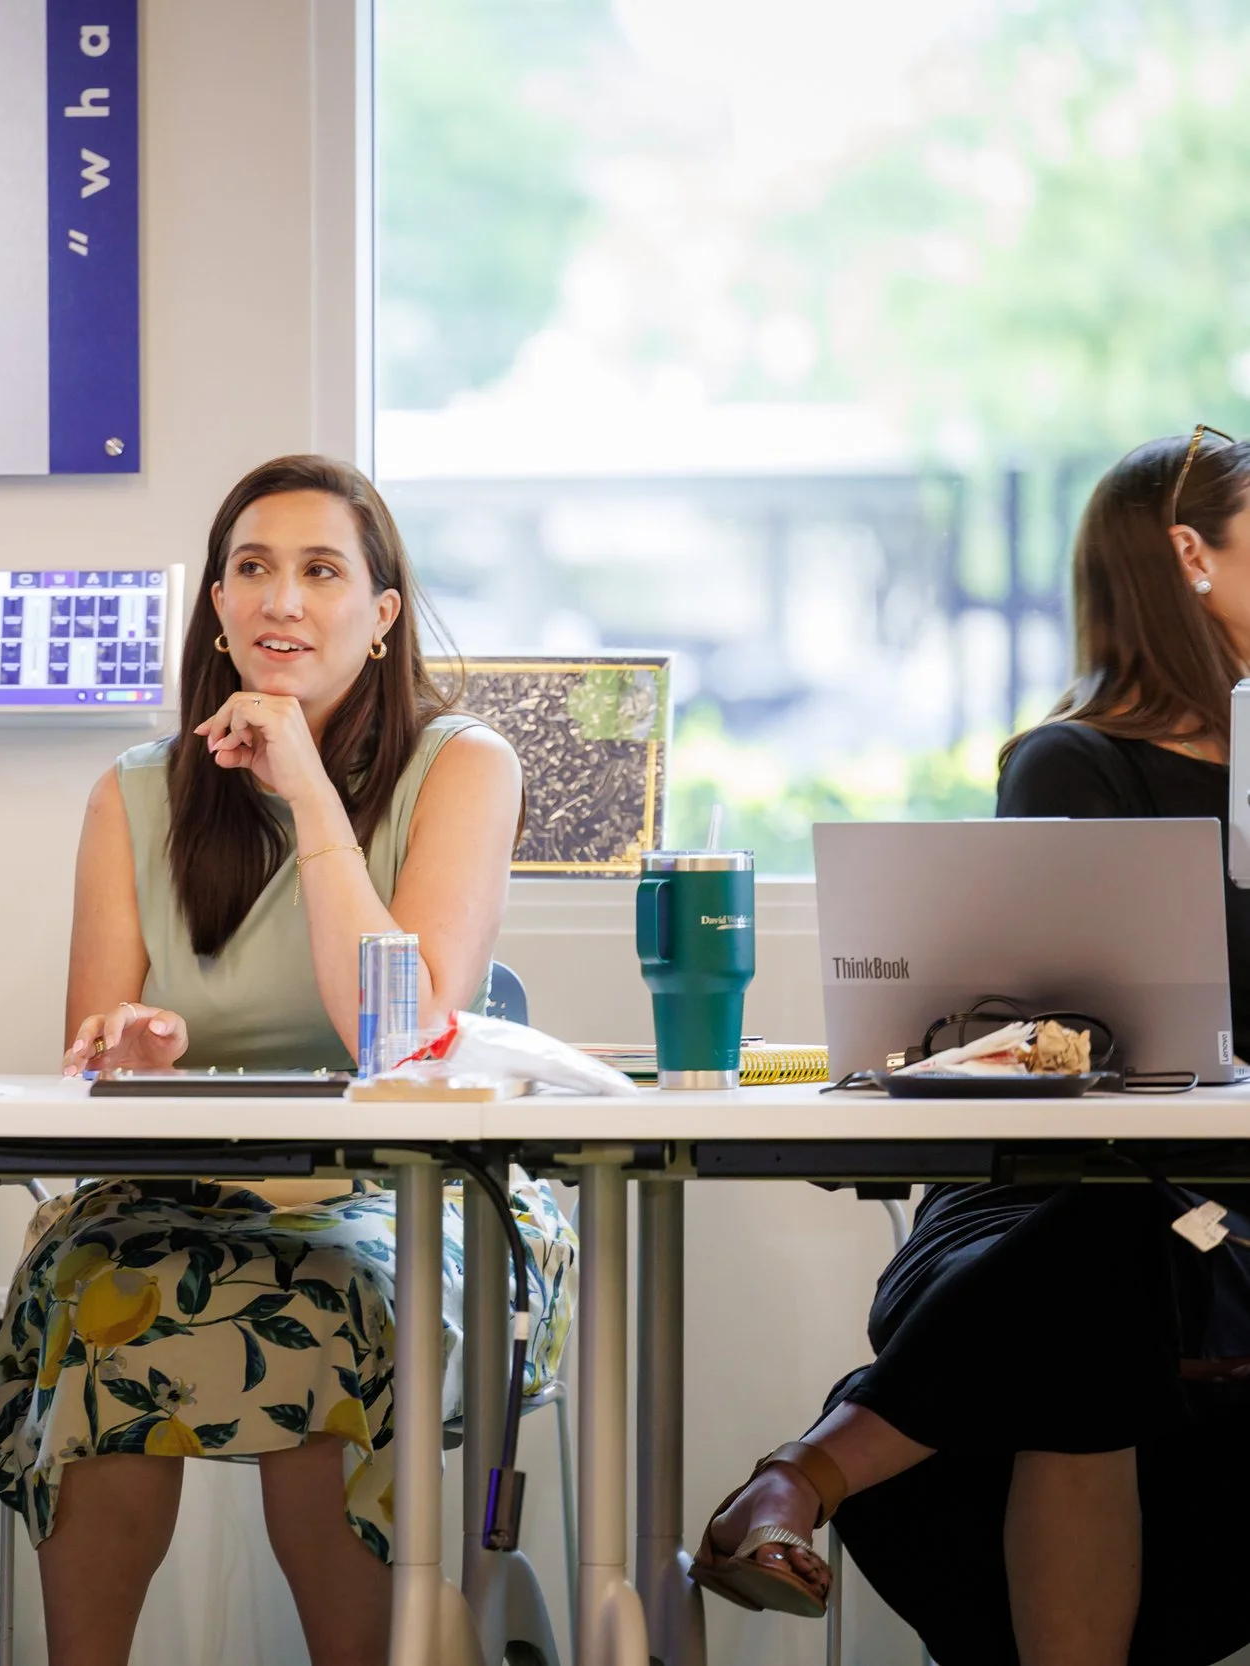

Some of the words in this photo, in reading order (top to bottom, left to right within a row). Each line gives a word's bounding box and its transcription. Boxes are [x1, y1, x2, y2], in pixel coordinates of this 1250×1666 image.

[701, 915, 726, 925] David
[832, 957, 910, 979] ThinkBook
[1222, 1033, 1230, 1062] Lenovo
